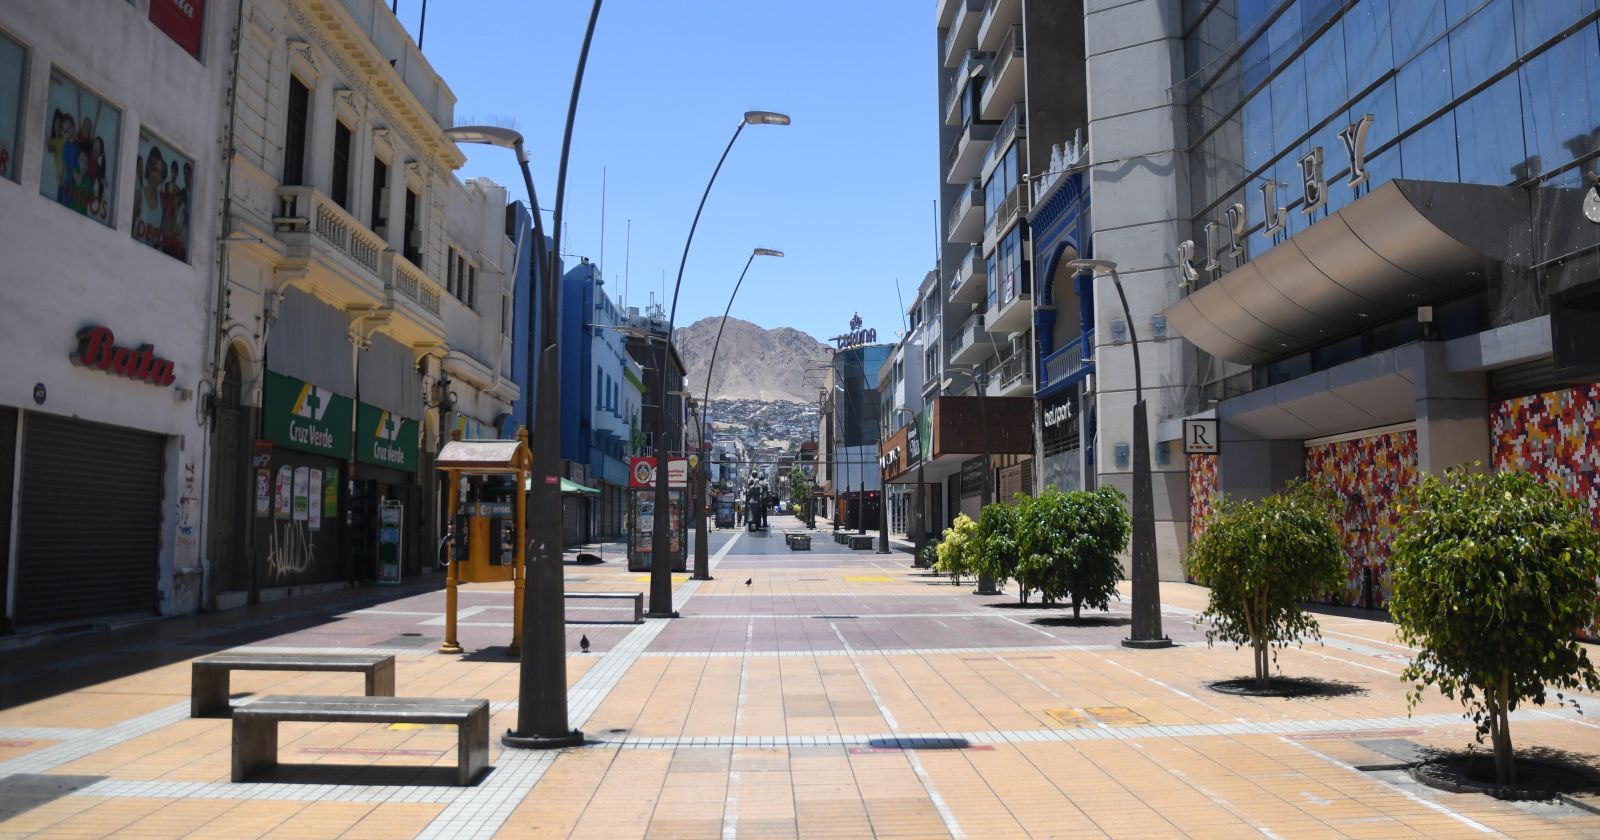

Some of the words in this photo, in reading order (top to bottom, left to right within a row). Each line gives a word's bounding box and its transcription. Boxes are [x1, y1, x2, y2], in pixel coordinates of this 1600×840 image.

[1178, 114, 1374, 288] RIPLEY
[70, 326, 176, 387] Bata
[290, 419, 308, 445] Cruz
[309, 424, 333, 448] Verde
[1192, 424, 1209, 445] R
[374, 441, 387, 461] Cruz
[387, 444, 405, 464] Verde
